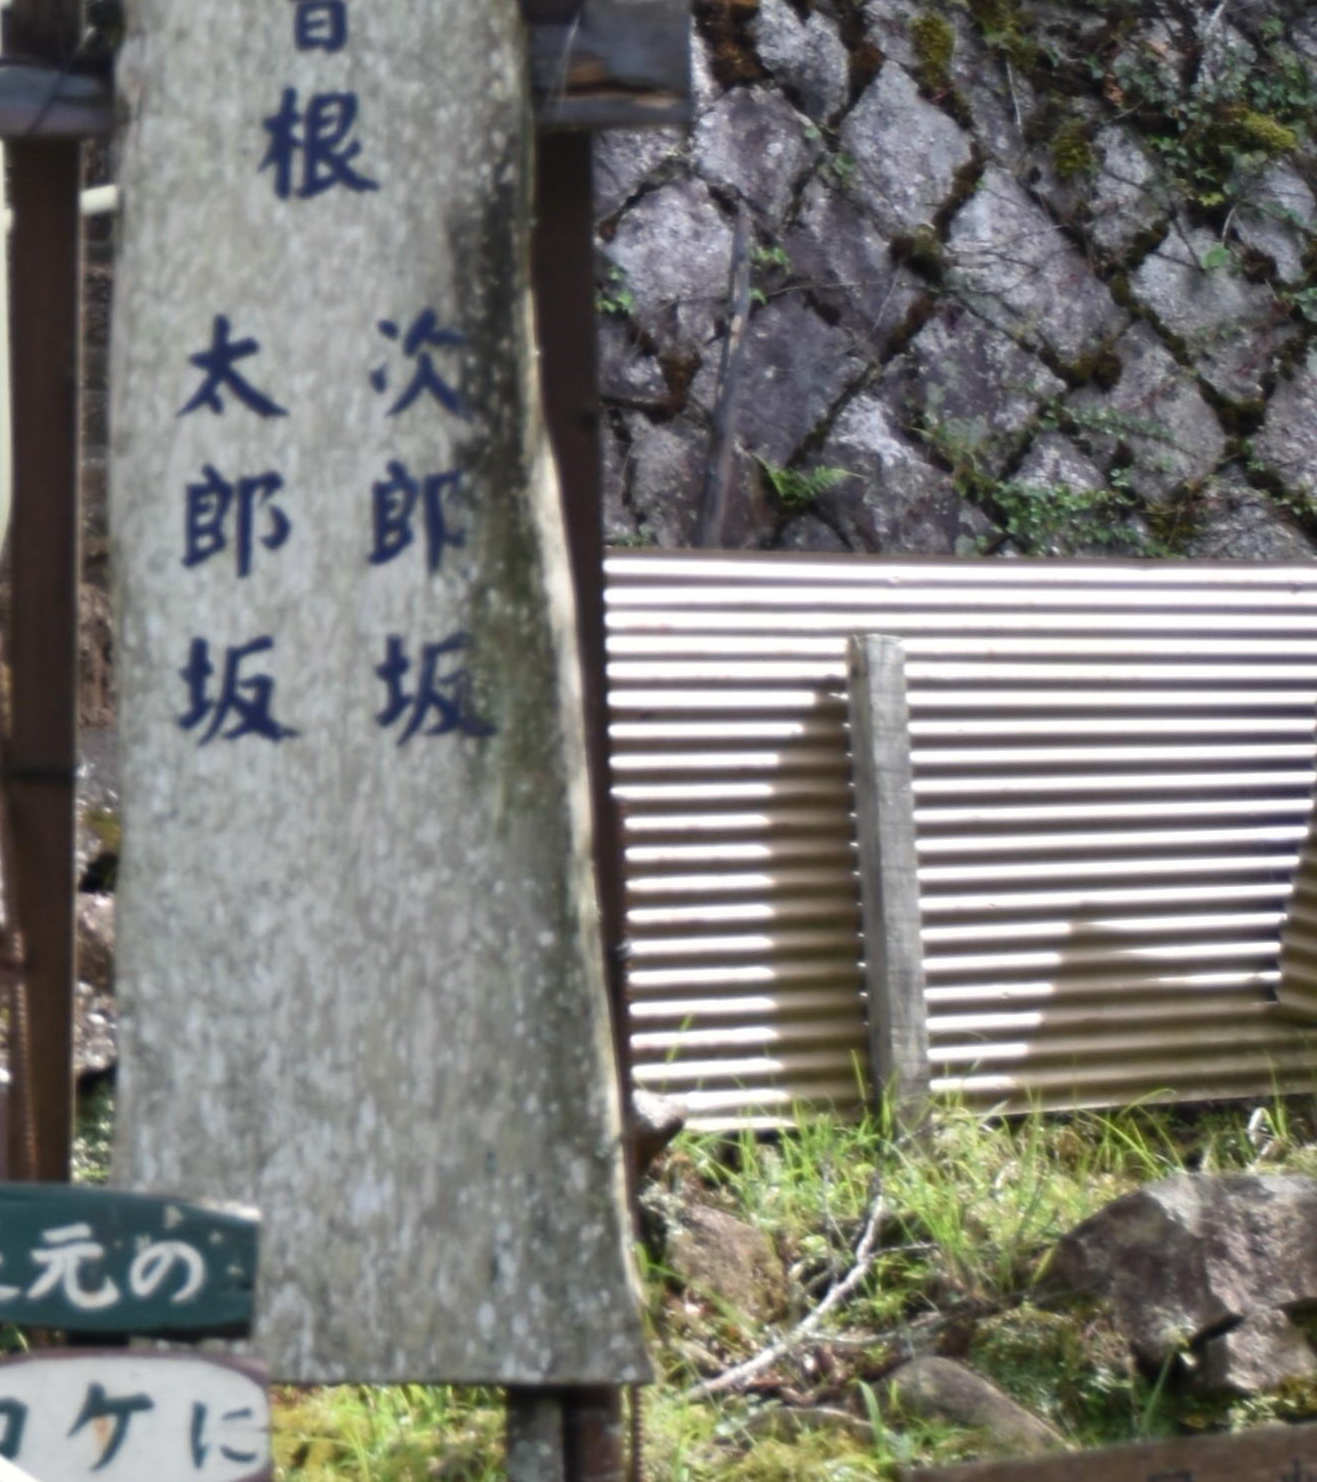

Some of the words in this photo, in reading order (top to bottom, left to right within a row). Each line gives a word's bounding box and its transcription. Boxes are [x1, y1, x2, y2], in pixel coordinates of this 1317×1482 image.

[176, 314, 301, 747] 太郎坂
[369, 306, 498, 747] 次郎坂
